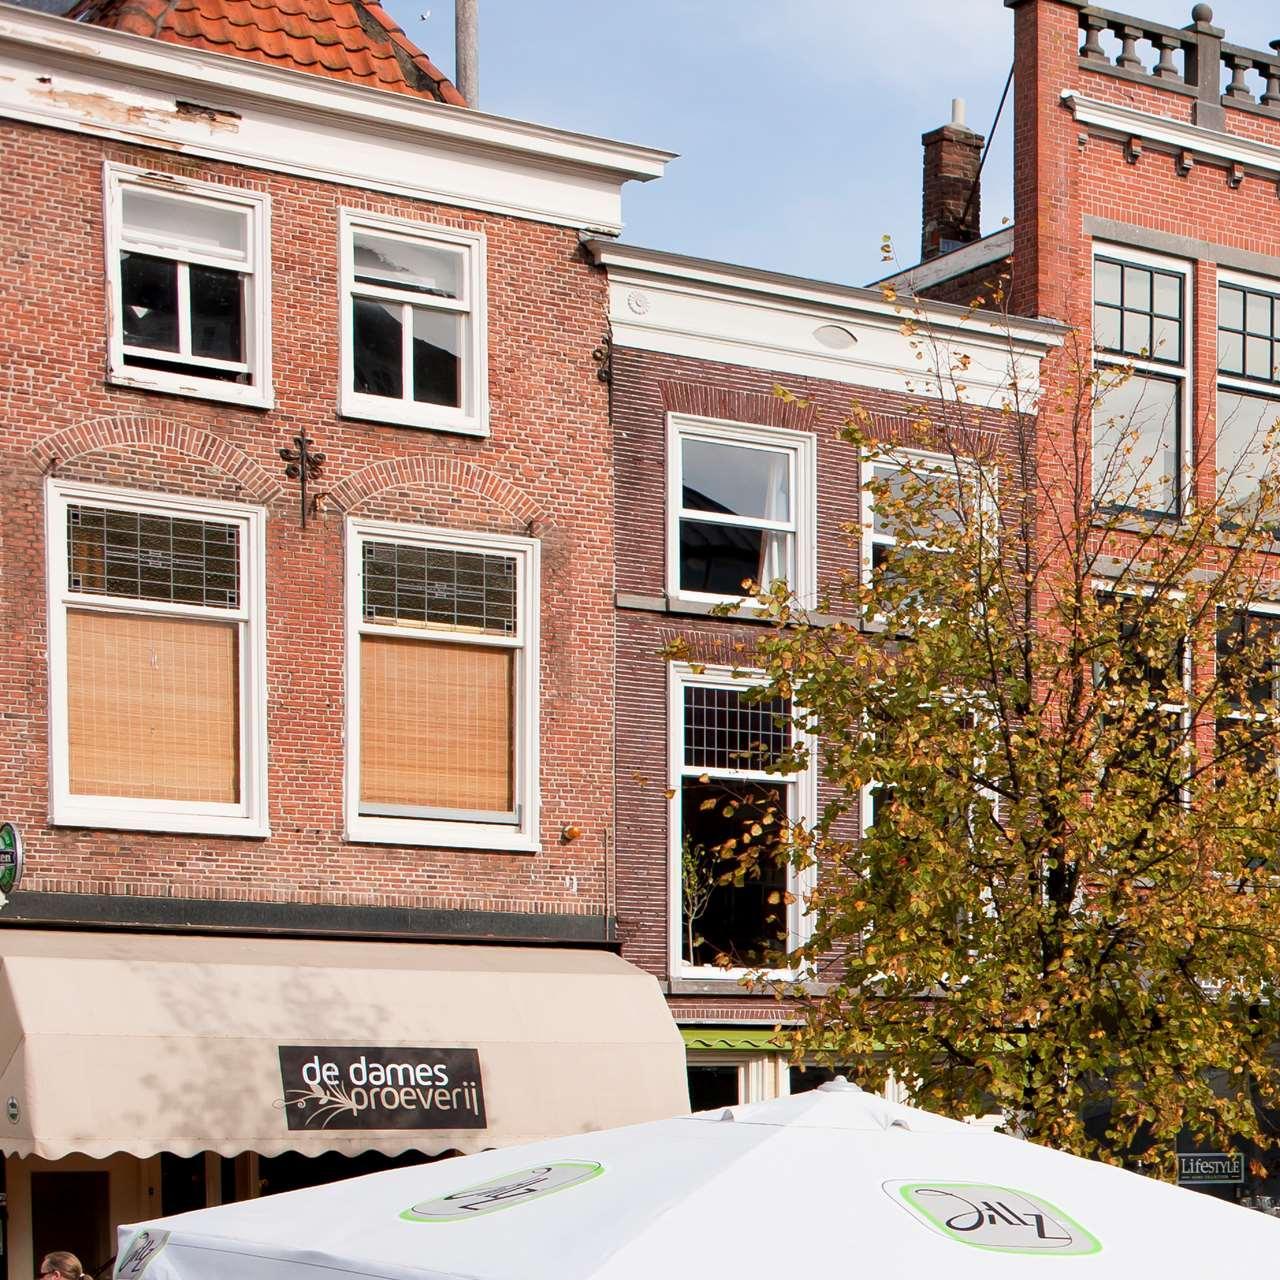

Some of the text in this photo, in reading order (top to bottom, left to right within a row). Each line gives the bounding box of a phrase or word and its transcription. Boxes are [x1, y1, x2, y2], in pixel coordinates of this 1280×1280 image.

[302, 1056, 449, 1085] de dames
[352, 1081, 480, 1117] proeverij
